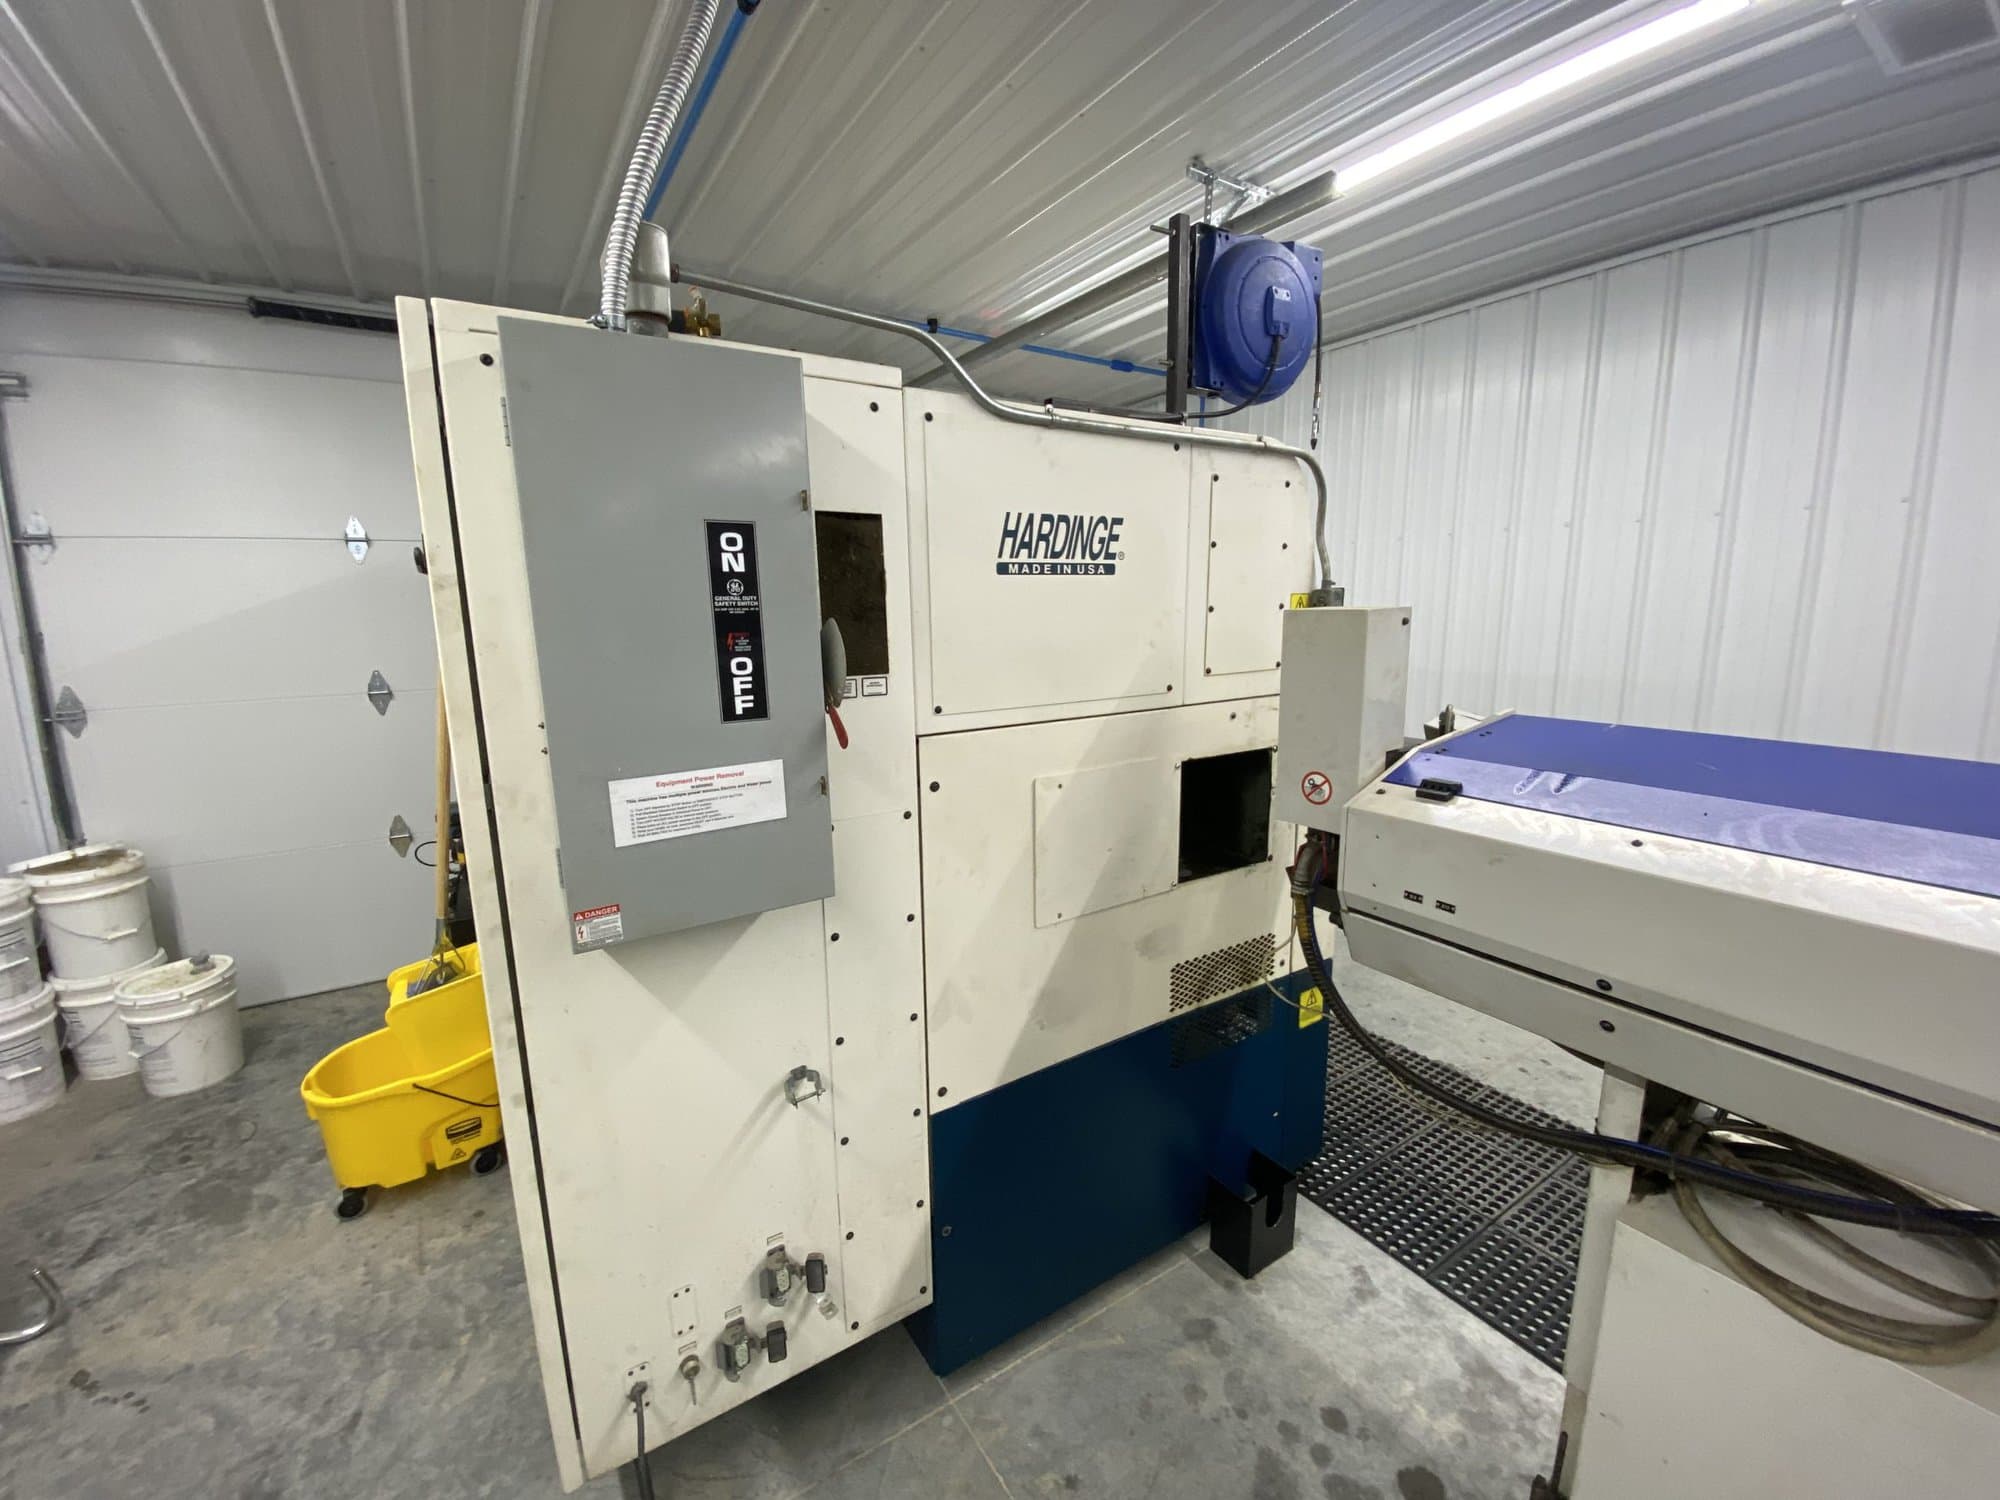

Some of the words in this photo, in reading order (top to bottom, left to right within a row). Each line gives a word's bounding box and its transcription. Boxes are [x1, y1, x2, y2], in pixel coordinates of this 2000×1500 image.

[998, 512, 1124, 560] HARDINGE
[720, 532, 745, 572] ON
[1008, 564, 1051, 574] MADE
[1058, 564, 1072, 574] IN
[1077, 564, 1105, 574] USA
[730, 657, 754, 715] OFF
[656, 778, 693, 788] Equipment
[584, 906, 618, 918] DANGER
